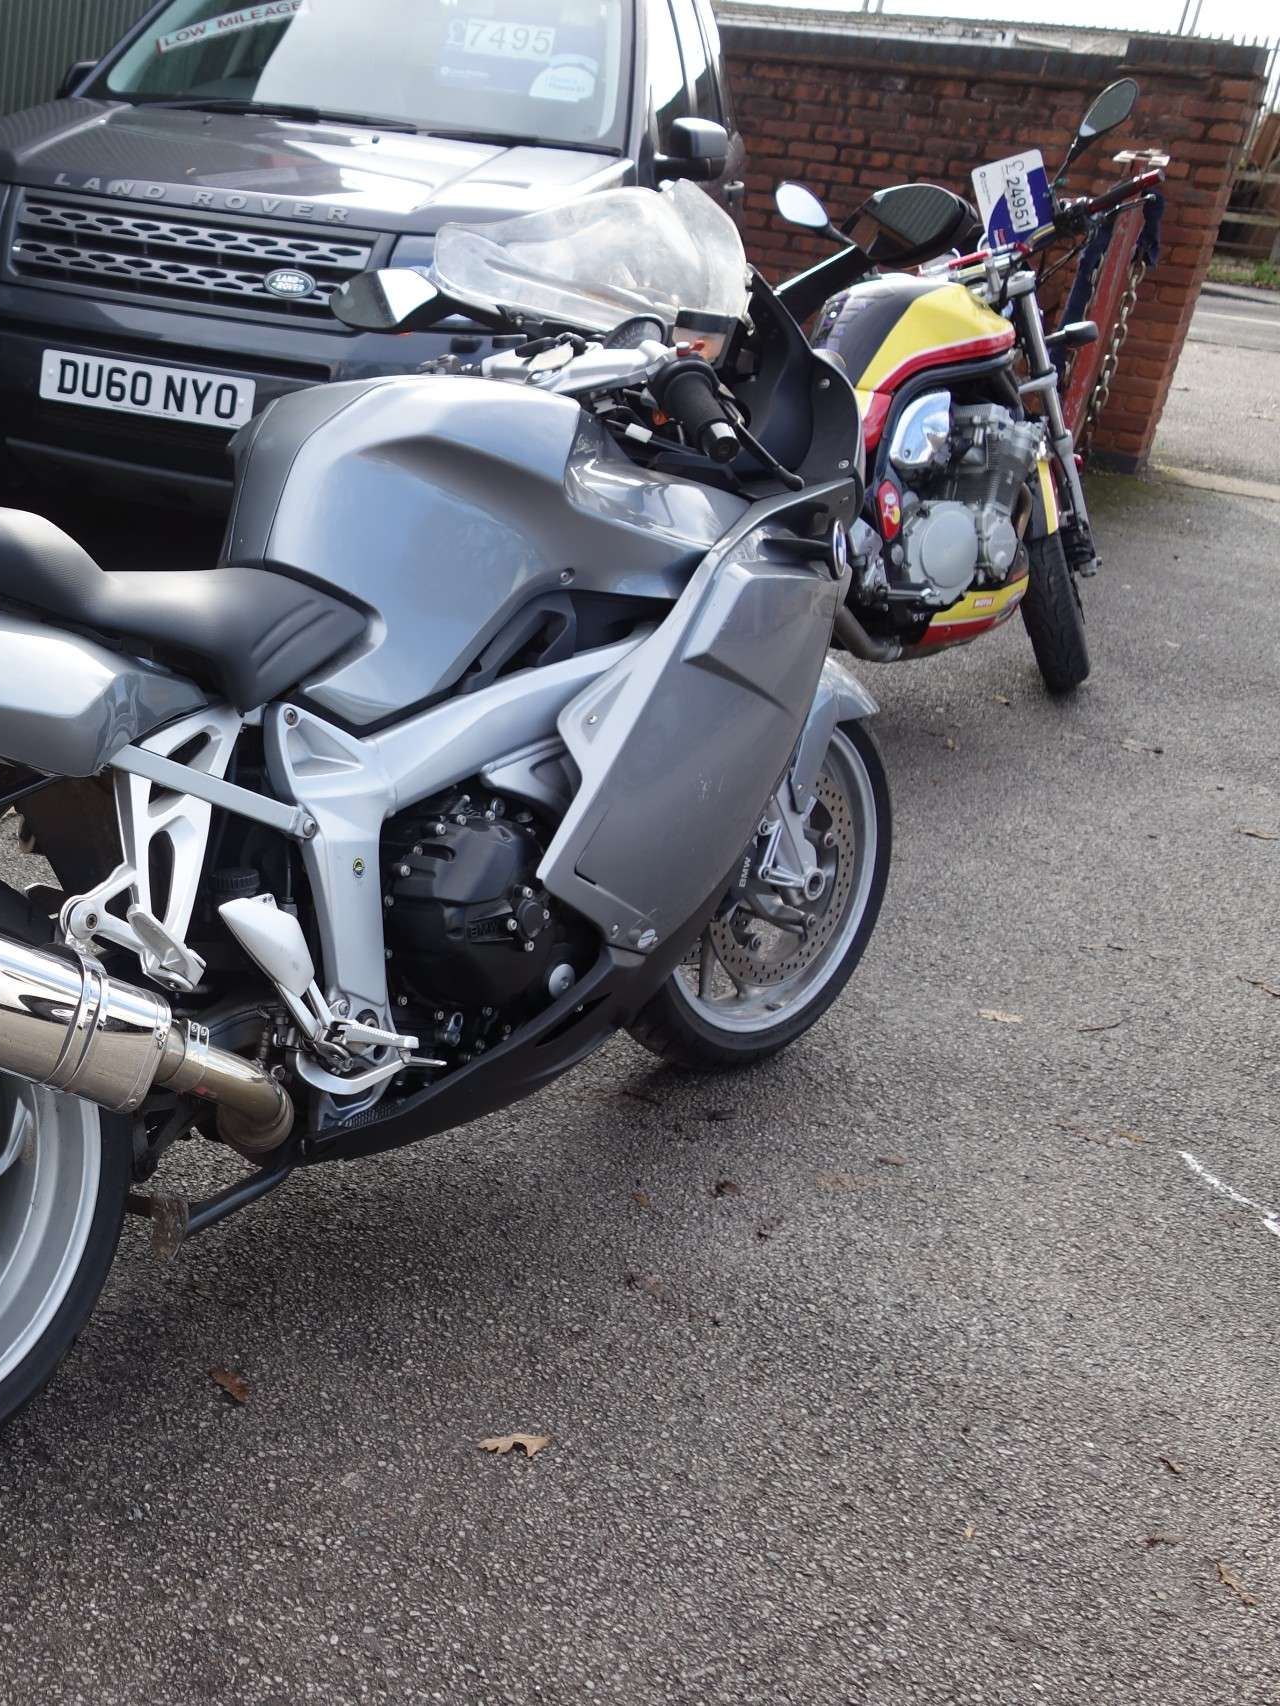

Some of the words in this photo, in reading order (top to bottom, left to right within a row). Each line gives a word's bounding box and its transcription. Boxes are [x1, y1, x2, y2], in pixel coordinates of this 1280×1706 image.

[164, 25, 207, 46] LOW
[217, 0, 303, 29] MILEAGE
[54, 173, 167, 201] LAND
[191, 190, 351, 223] ROVER
[57, 358, 152, 406] DU60
[163, 373, 238, 420] NYO
[738, 856, 752, 888] BMW
